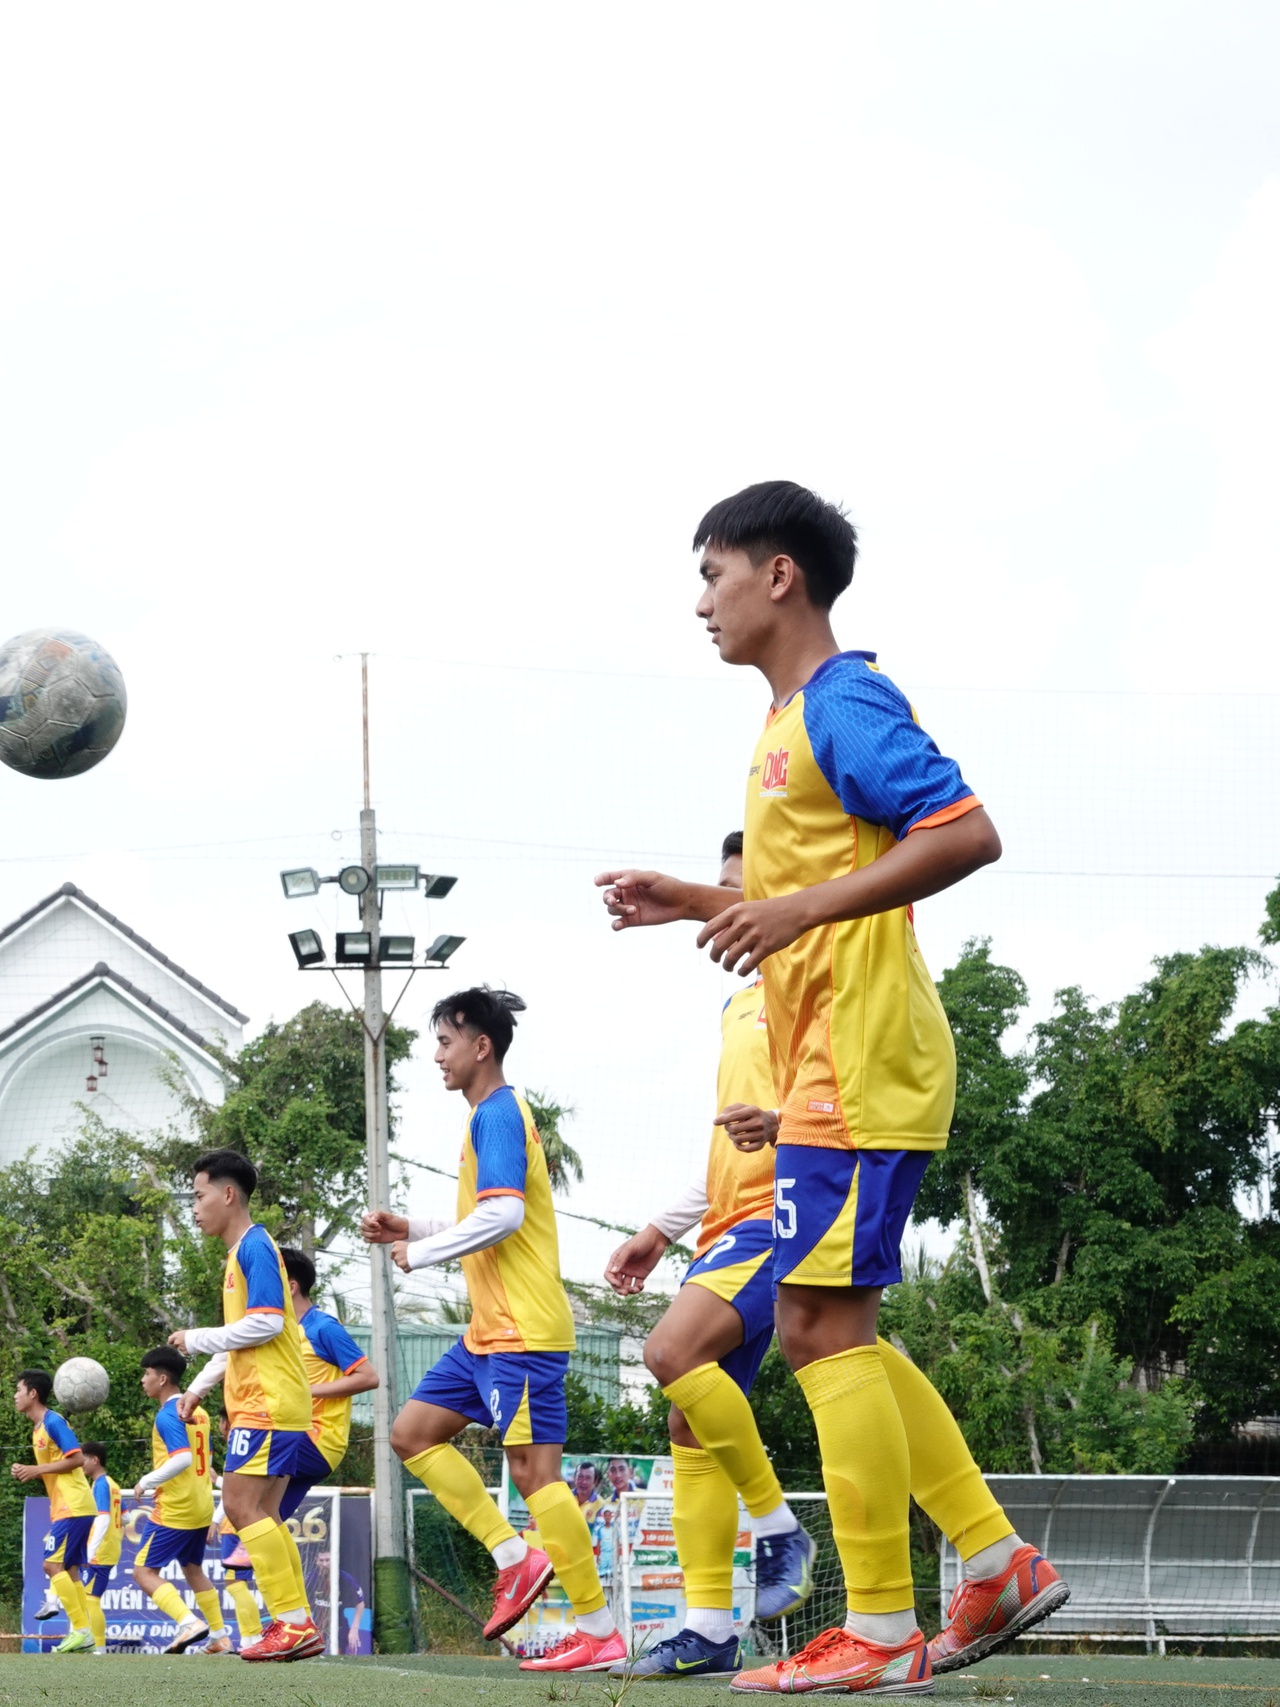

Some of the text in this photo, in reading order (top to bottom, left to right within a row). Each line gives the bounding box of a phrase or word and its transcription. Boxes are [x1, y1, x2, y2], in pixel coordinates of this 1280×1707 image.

[231, 1429, 252, 1456] 16
[101, 1584, 142, 1610] UYẾN
[105, 1621, 146, 1638] OÁN
